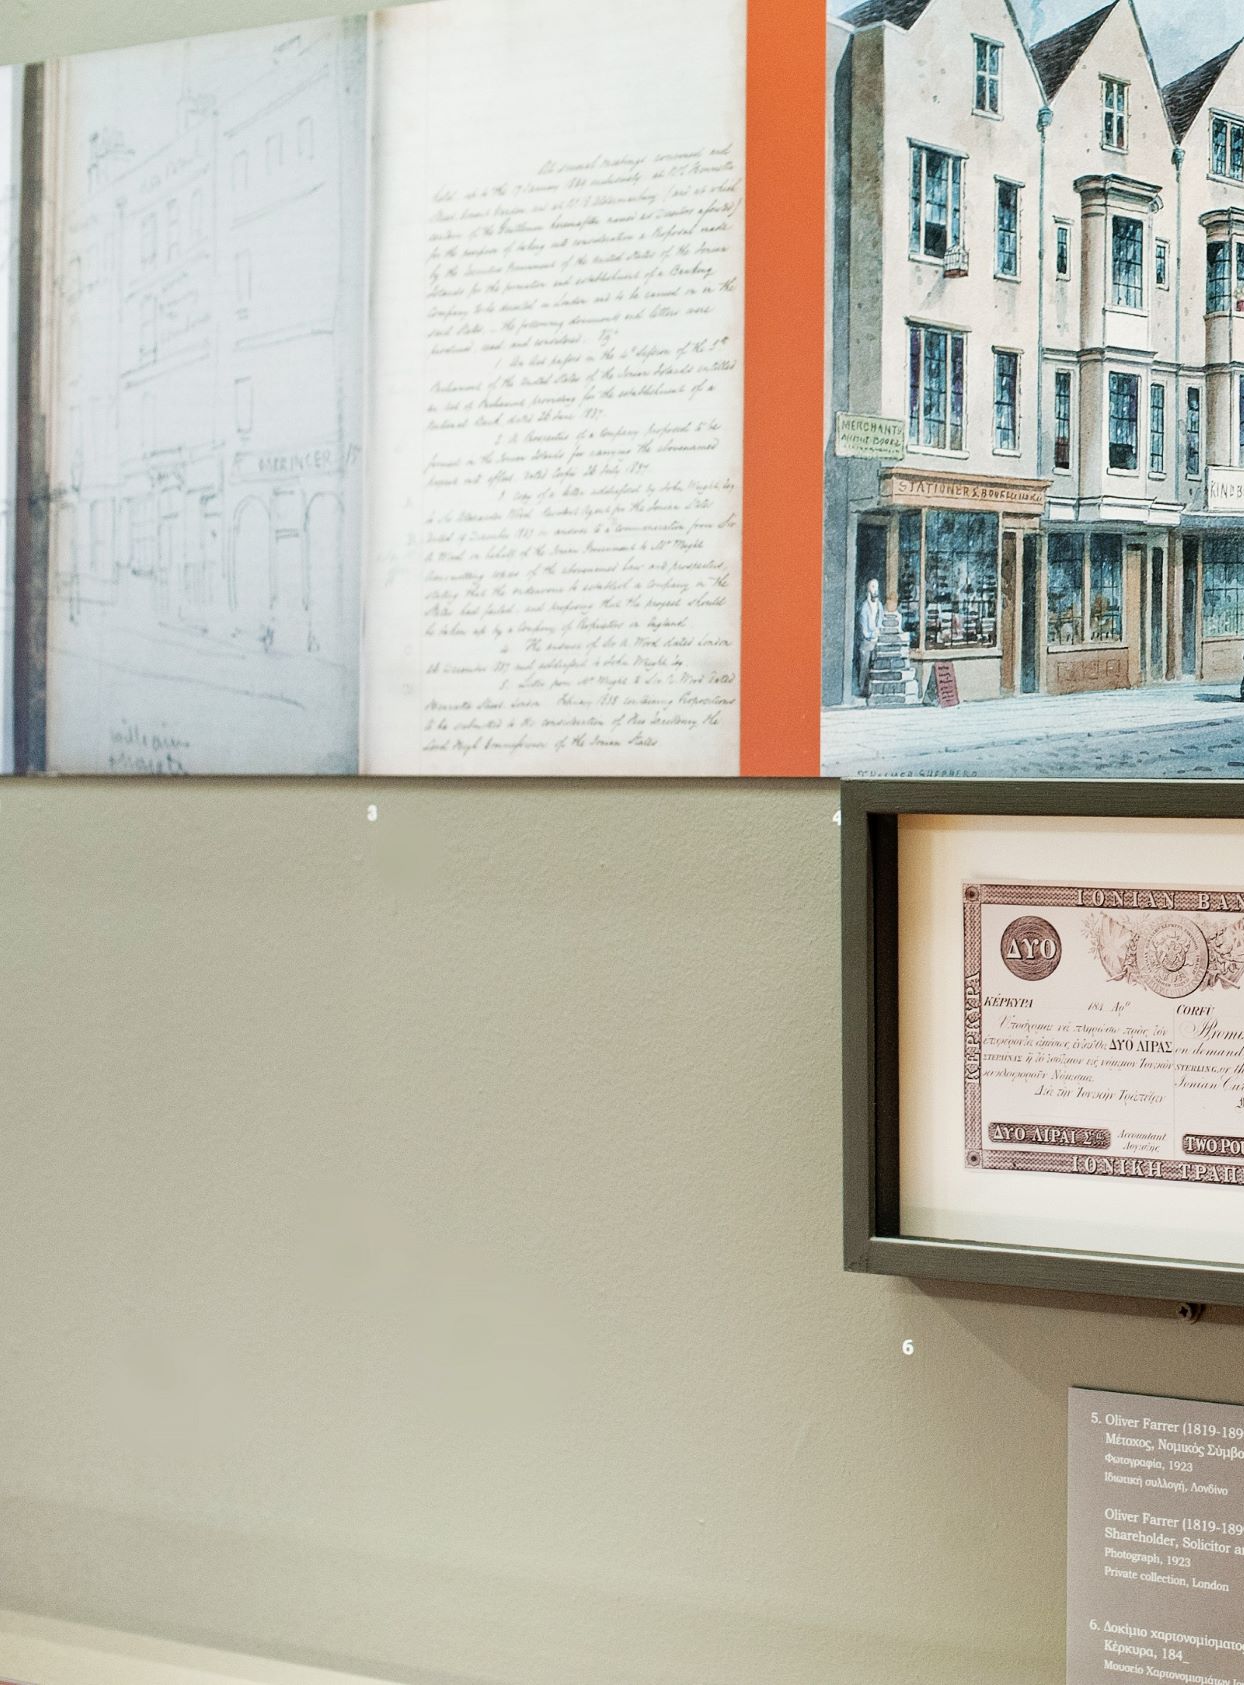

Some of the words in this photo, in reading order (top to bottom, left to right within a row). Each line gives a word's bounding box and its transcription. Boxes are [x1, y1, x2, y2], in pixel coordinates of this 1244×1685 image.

[367, 804, 378, 821] 3
[832, 809, 842, 826] 4
[1076, 889, 1176, 910] IONIAN
[1006, 938, 1058, 960] ΔΥΟ
[1109, 1038, 1134, 1051] ΔΥΟ
[1191, 1043, 1243, 1059] demand
[993, 1126, 1026, 1141] ΔΥΟ
[1185, 1136, 1218, 1153] TWO
[902, 1339, 914, 1356] 6
[1091, 1412, 1102, 1425] 5.
[1105, 1414, 1140, 1428] Oliver
[1142, 1417, 1180, 1433] Farrer
[1105, 1433, 1155, 1451] Μέτοχος,
[1158, 1438, 1205, 1457] Νομικός
[1104, 1452, 1166, 1471] Φωτογραφία,
[1168, 1460, 1194, 1473] 1923
[1104, 1471, 1143, 1487] Ιδιωτική
[1145, 1478, 1189, 1494] συλλογή,
[1190, 1482, 1229, 1496] Λονδίνο
[1104, 1507, 1139, 1523] Oliver
[1142, 1512, 1180, 1528] Farrer
[1104, 1527, 1180, 1549] Shareholder,
[1182, 1536, 1232, 1554] Solicitor
[1104, 1546, 1164, 1566] Photograph,
[1167, 1555, 1192, 1567] 1923
[1104, 1565, 1138, 1581] Private
[1139, 1571, 1190, 1589] collection,
[1192, 1577, 1230, 1592] London
[1089, 1618, 1101, 1632] 6.
[1103, 1620, 1148, 1638] Δοκίμιο
[1104, 1639, 1158, 1659] Κέρκυρα,
[1104, 1659, 1144, 1675] Μουσείο
